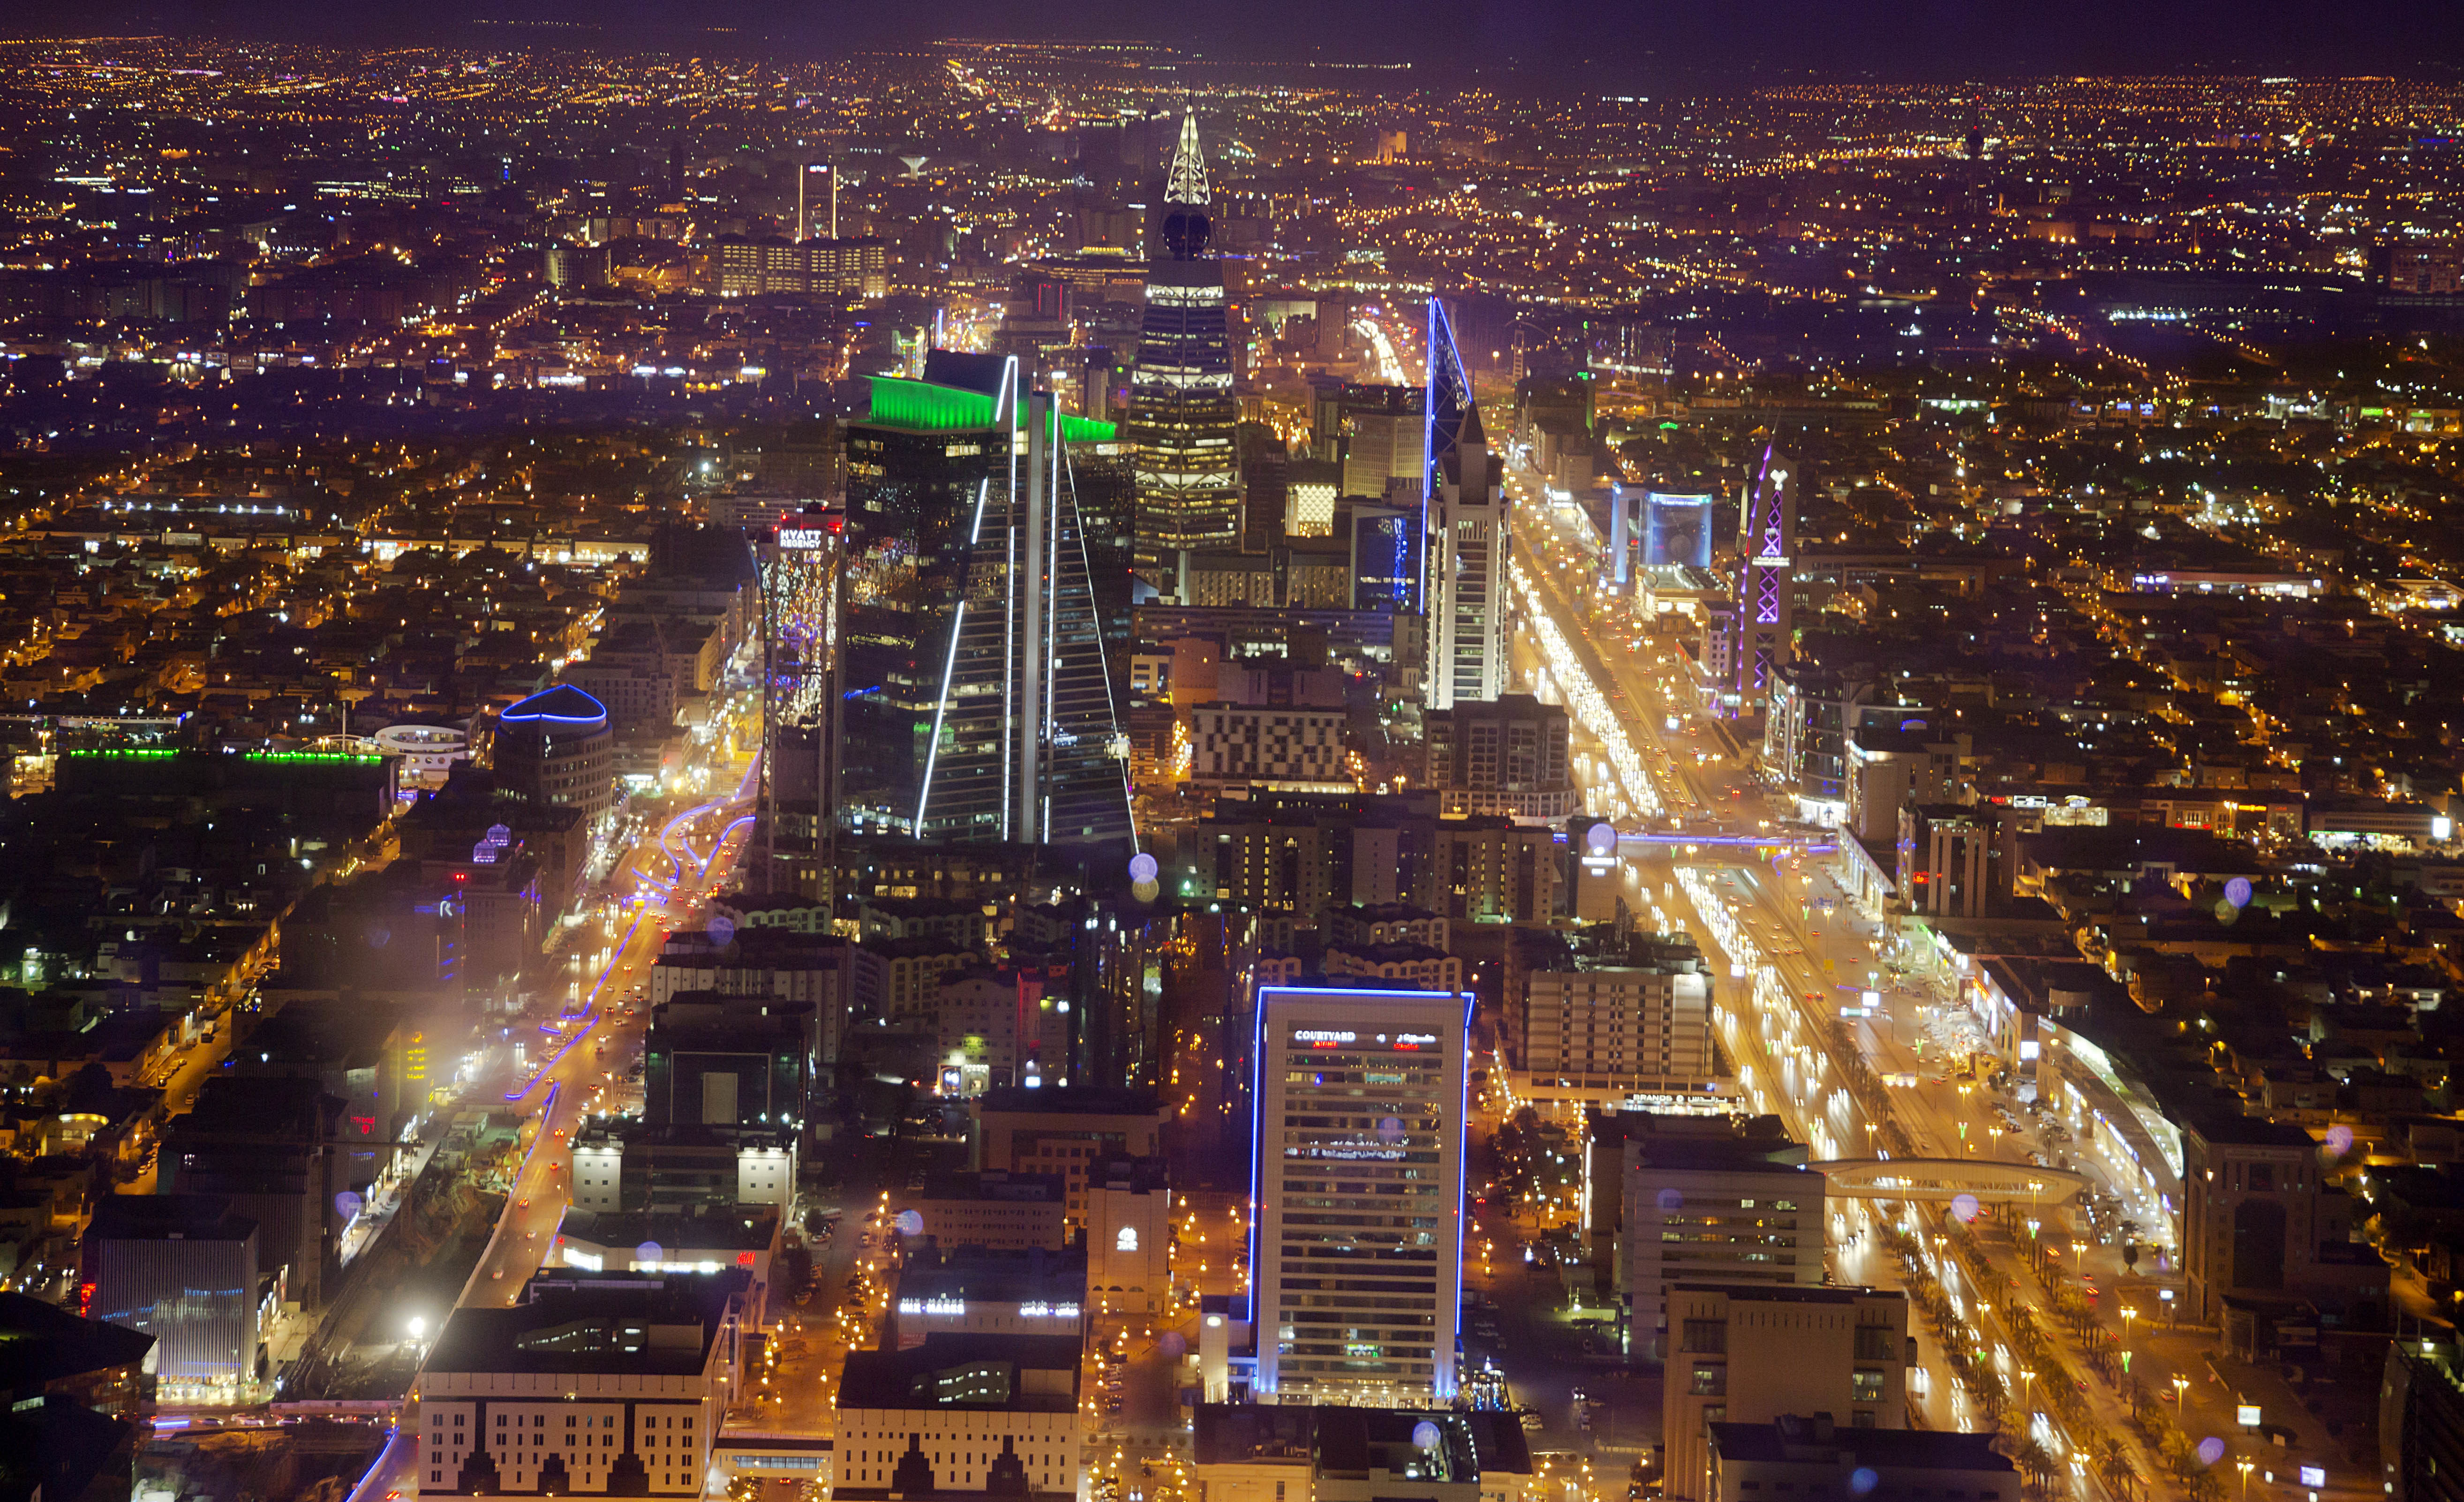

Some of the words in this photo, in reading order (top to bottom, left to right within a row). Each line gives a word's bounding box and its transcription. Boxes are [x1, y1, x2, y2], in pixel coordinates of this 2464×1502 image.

[780, 530, 821, 540] HYATT
[780, 539, 821, 548] REGENCY
[1295, 1030, 1356, 1041] COURTYARD
[900, 1299, 921, 1313] MIX
[927, 1300, 965, 1314] MARKS
